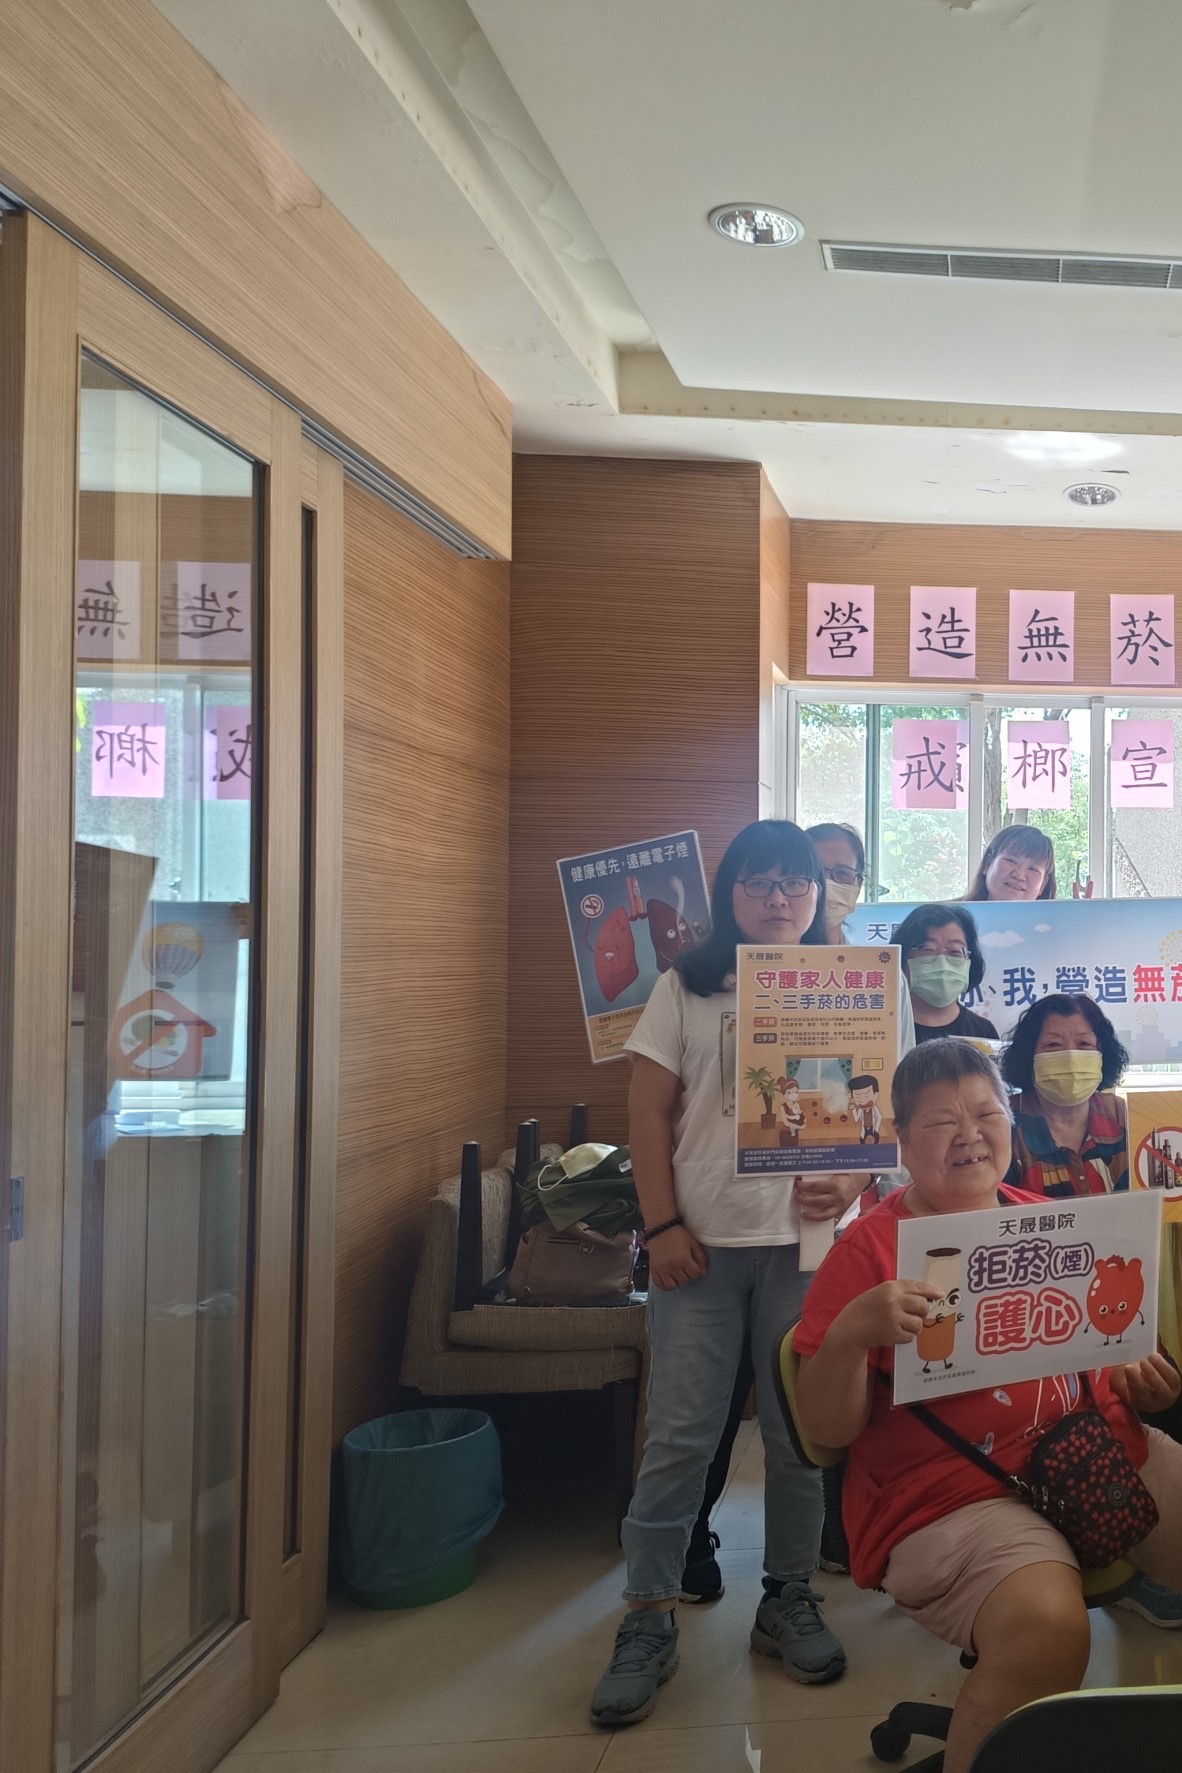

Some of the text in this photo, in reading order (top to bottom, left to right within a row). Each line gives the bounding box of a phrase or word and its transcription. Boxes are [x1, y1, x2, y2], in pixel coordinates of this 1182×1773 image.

[571, 842, 689, 883] 健康優先，遠離電子煙
[746, 952, 784, 961] 天晟醫院
[755, 970, 885, 990] 守護家人健康
[754, 993, 885, 1010] 二、三手菸的危害
[998, 1213, 1076, 1238] 天晟醫院
[970, 1239, 1092, 1289] 拒菸(煙)
[978, 1290, 1079, 1352] 護心
